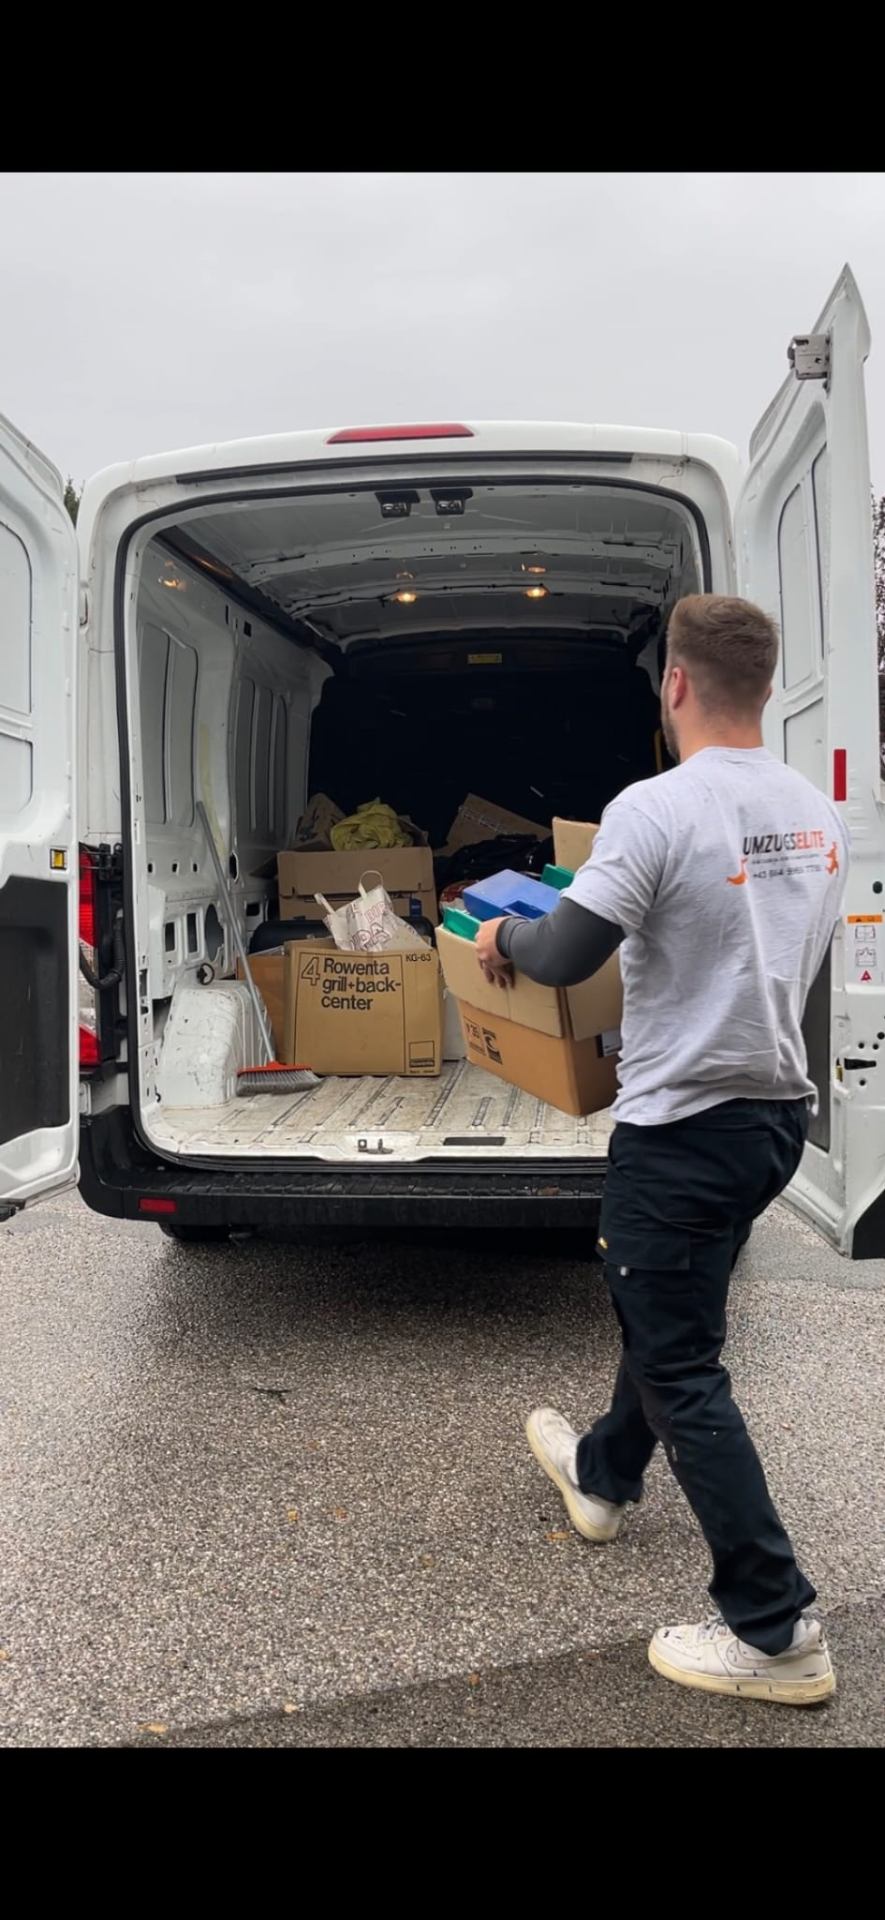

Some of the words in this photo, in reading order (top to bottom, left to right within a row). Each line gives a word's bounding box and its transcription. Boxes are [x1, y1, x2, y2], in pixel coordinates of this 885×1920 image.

[743, 831, 825, 855] UMZUGSELITE
[405, 953, 432, 962] KG-63
[301, 957, 321, 986] 4
[323, 958, 390, 975] Rowenta
[322, 976, 402, 994] grill+back-
[321, 995, 374, 1011] center
